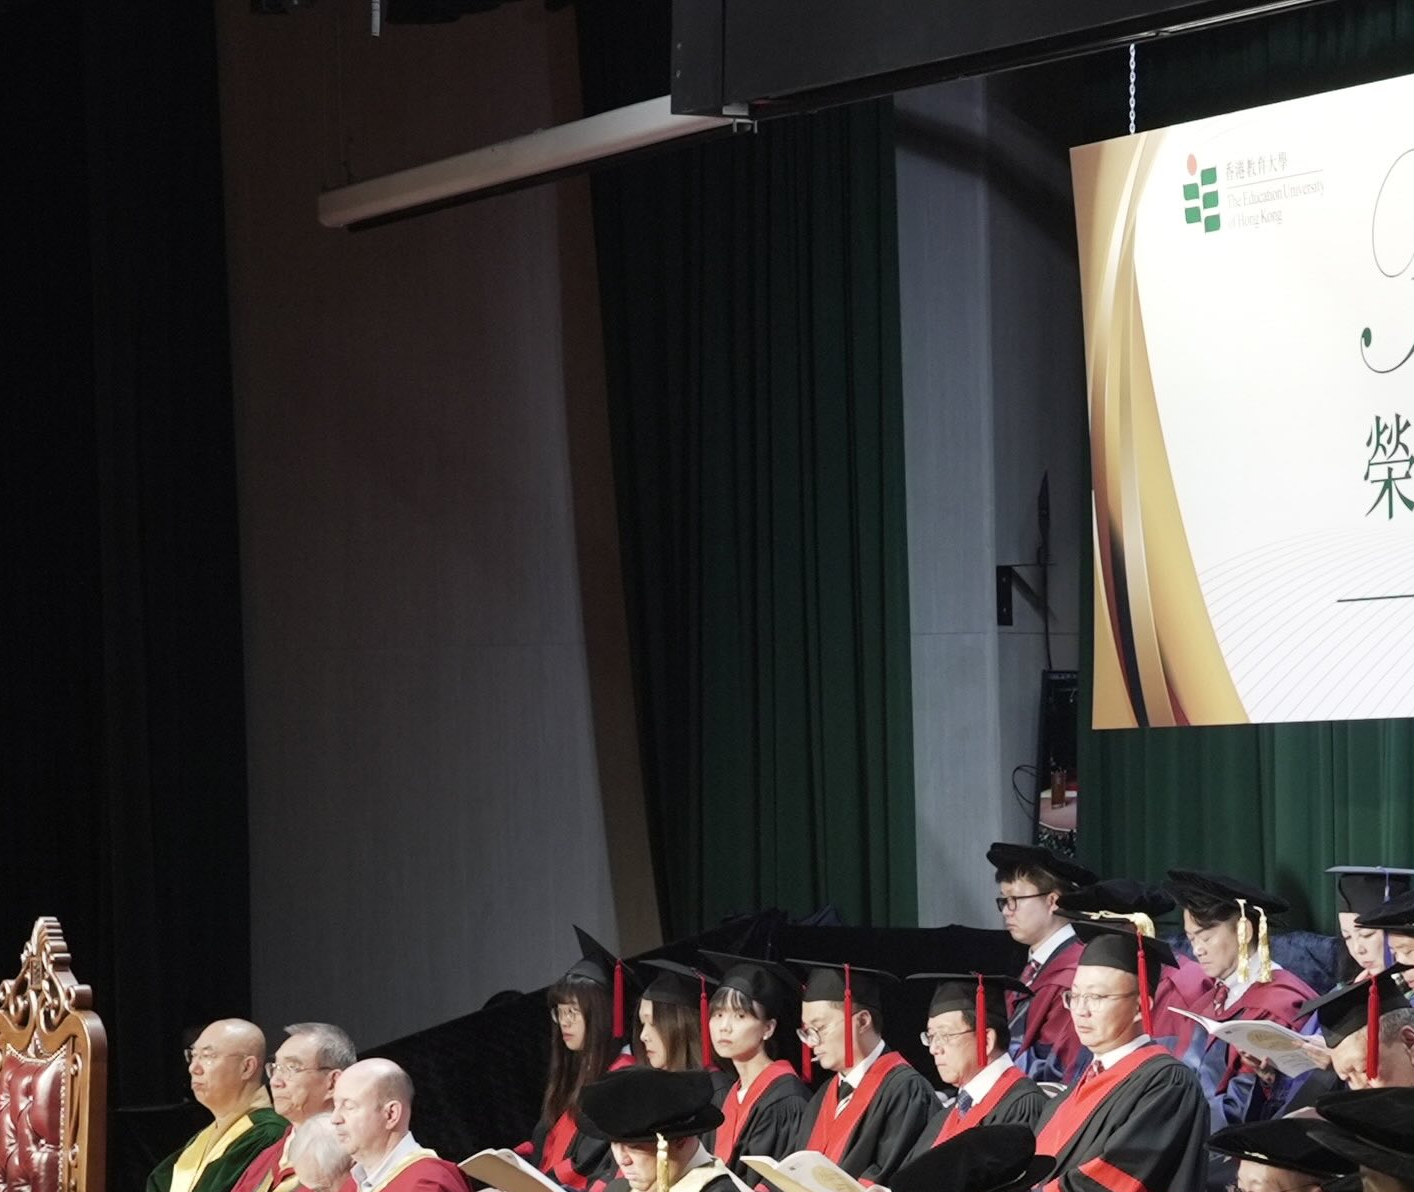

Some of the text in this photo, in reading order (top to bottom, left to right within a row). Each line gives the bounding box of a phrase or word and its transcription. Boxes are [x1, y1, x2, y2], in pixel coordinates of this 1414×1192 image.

[1242, 188, 1282, 206] Education
[1283, 180, 1325, 200] University
[1237, 211, 1260, 230] Hong
[1260, 207, 1283, 225] Kong
